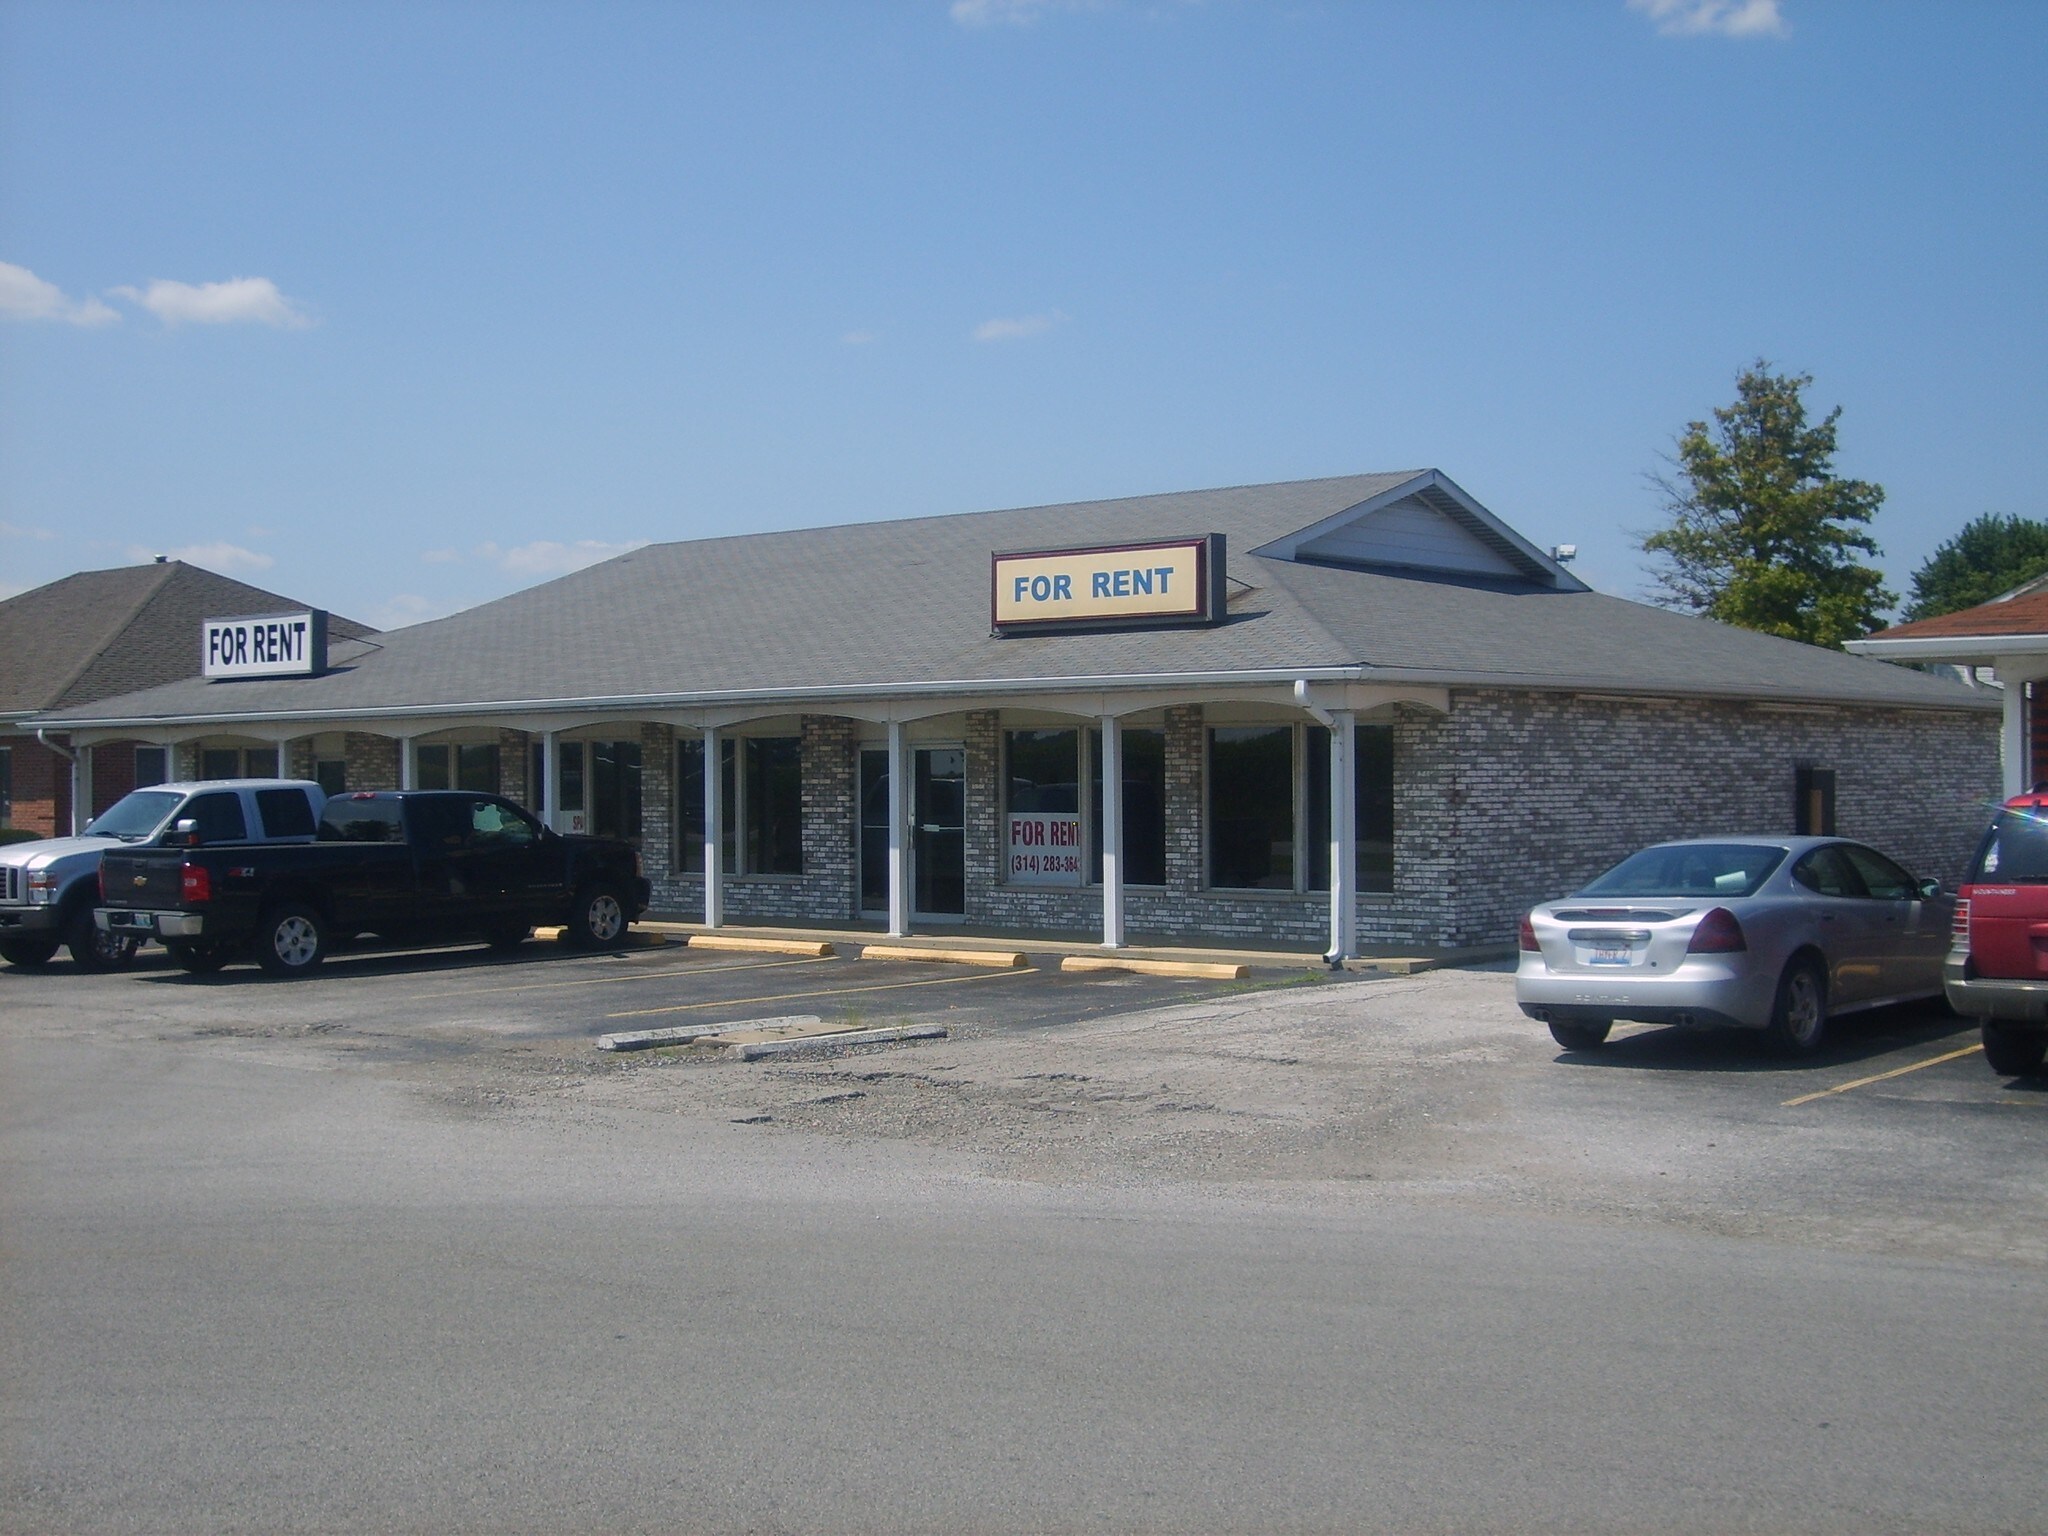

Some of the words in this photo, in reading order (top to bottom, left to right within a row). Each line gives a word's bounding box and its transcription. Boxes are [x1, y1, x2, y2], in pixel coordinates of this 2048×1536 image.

[1014, 575, 1073, 602] FOR
[1092, 567, 1174, 598] RENT
[210, 627, 247, 666] FOR
[253, 622, 305, 663] RENT
[1011, 820, 1045, 846] FOR
[1011, 854, 1040, 875] (314)
